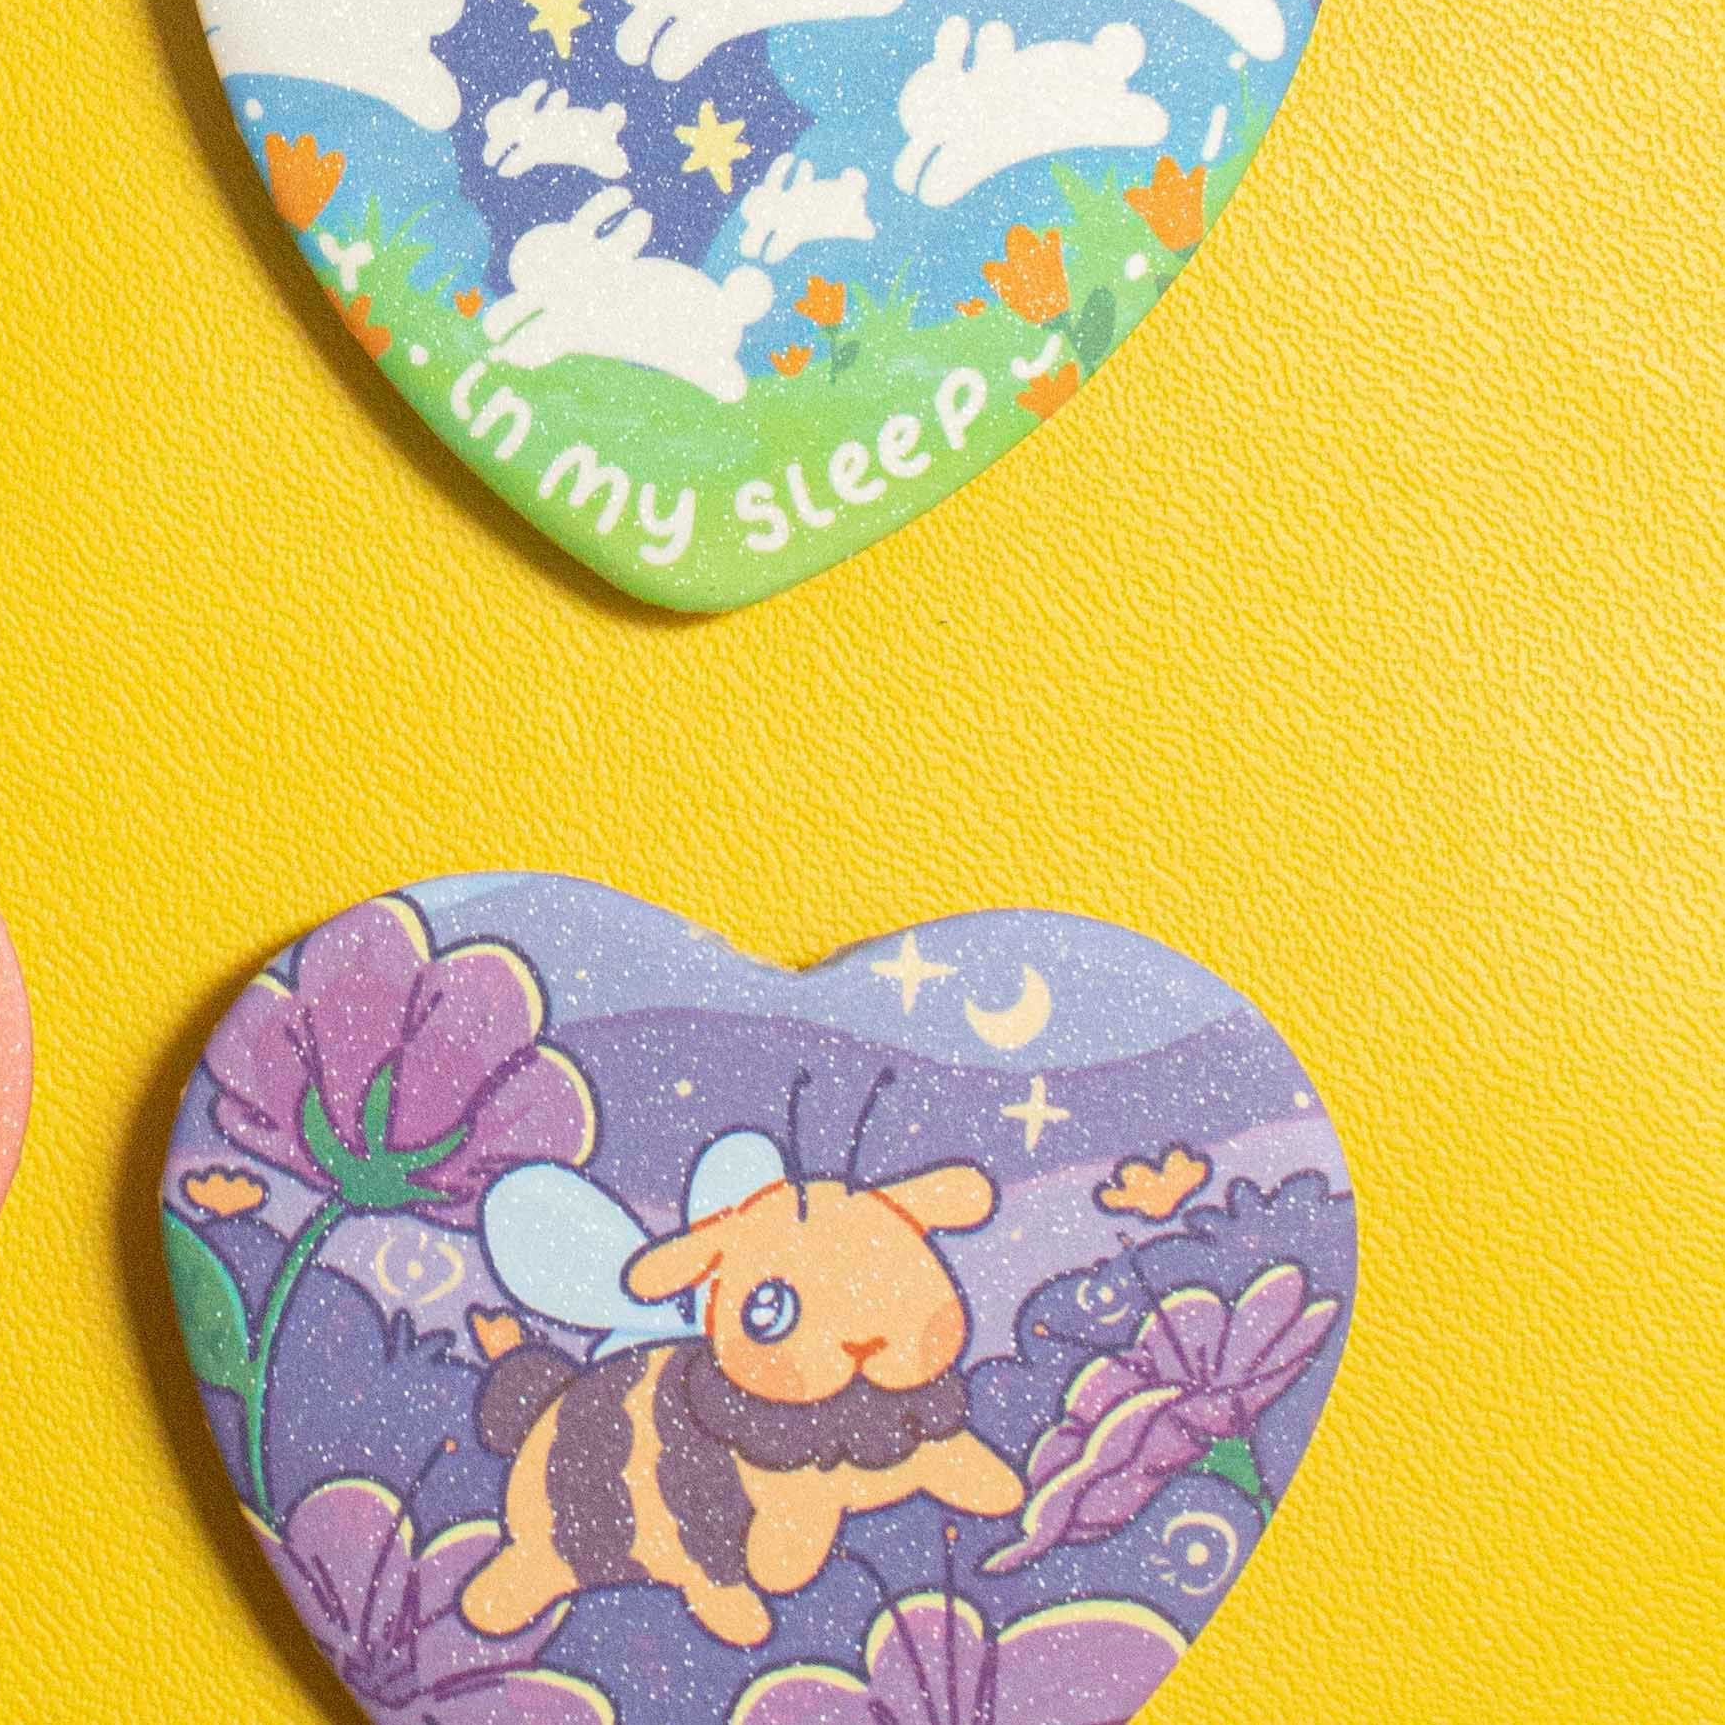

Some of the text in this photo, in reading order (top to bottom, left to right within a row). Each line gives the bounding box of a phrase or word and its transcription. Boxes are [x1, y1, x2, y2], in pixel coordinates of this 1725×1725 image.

[450, 359, 988, 565] in my sleep
